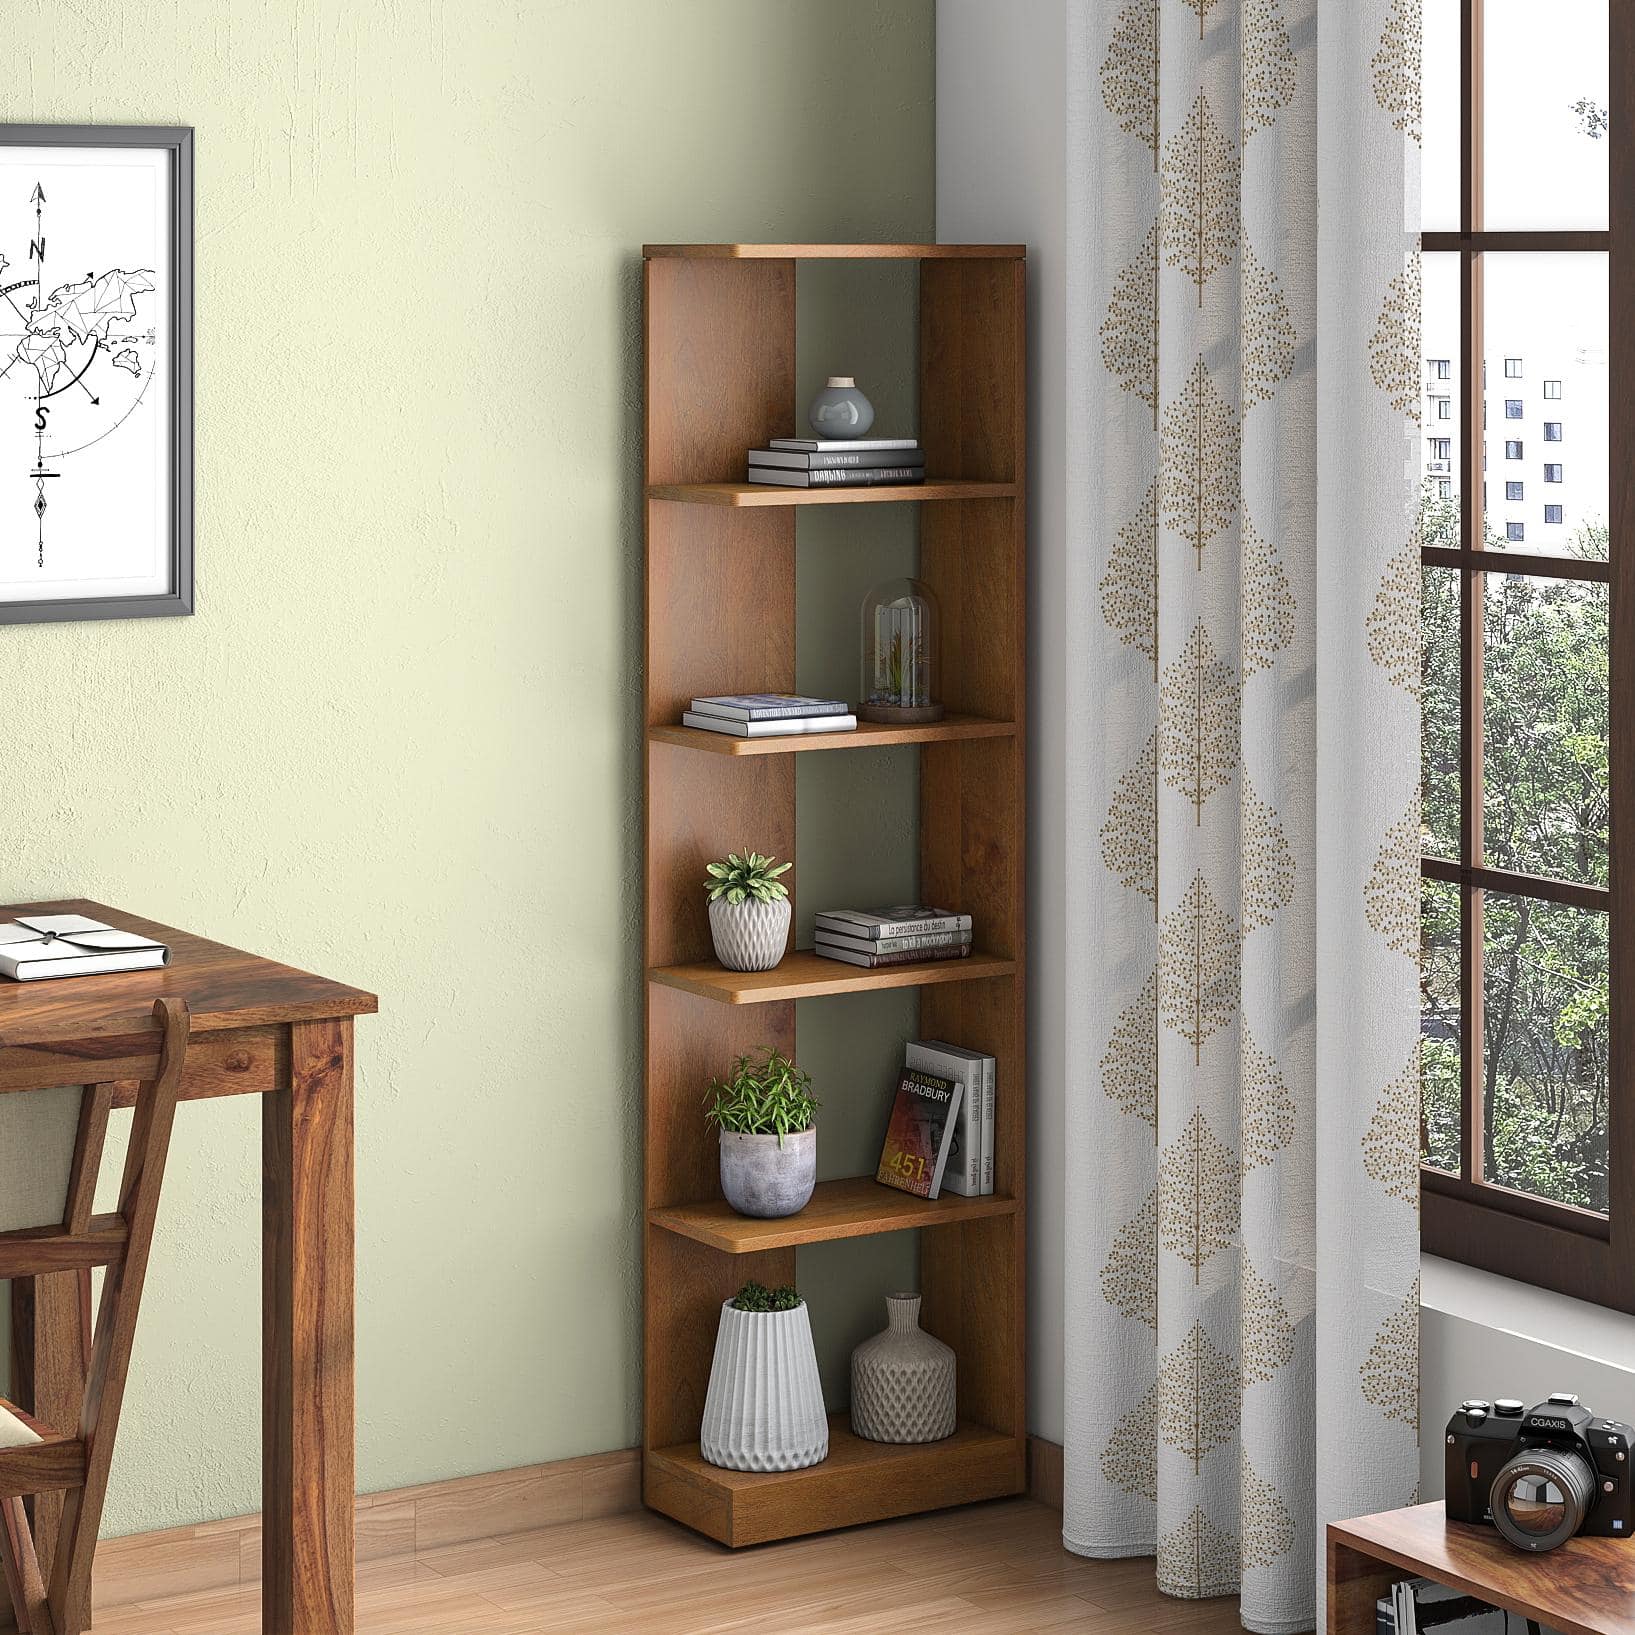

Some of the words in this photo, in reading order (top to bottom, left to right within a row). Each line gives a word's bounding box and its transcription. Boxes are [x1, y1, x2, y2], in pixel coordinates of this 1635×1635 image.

[29, 237, 46, 262] N
[34, 407, 50, 430] S
[923, 920, 931, 931] du
[901, 1080, 951, 1103] BRADBURY
[909, 1072, 947, 1090] RAYMOND
[889, 1151, 925, 1180] 451
[1530, 1417, 1566, 1429] CGAXIS
